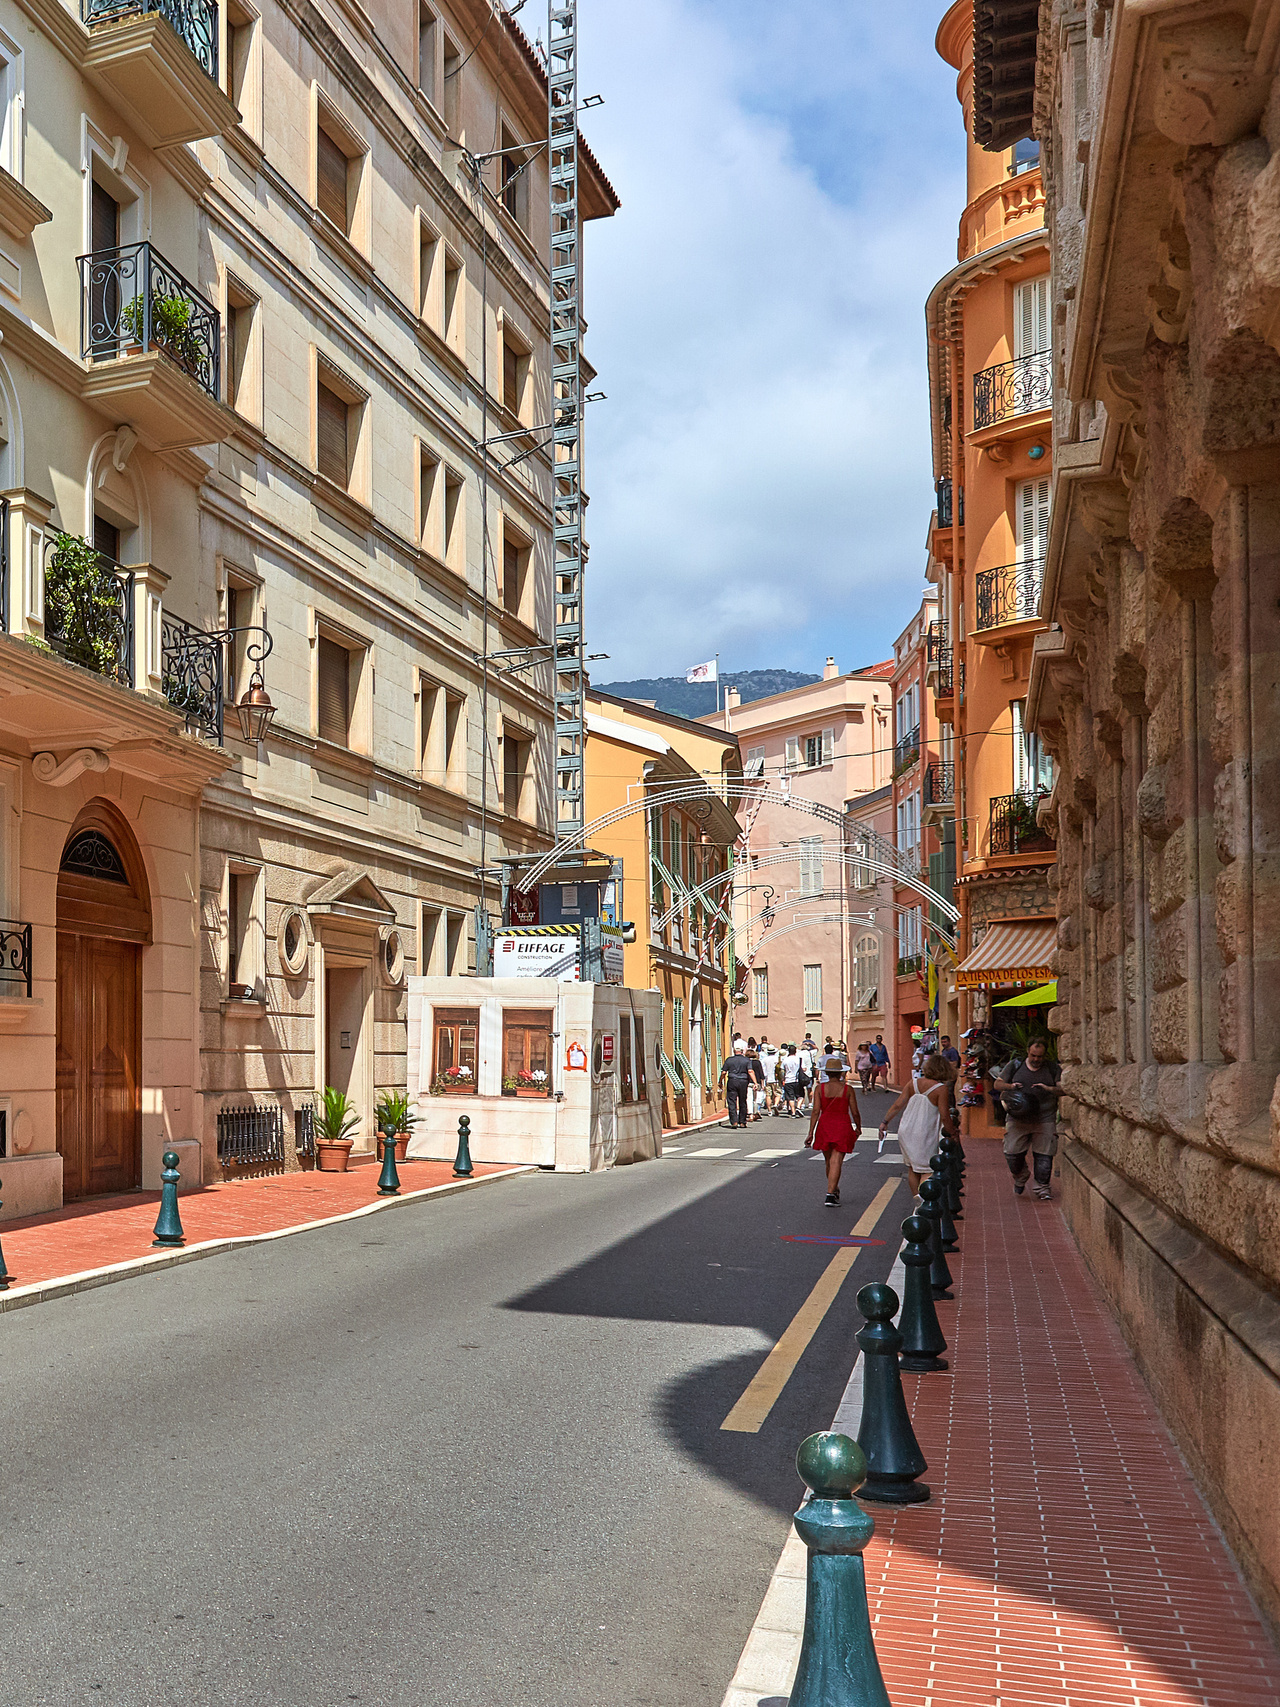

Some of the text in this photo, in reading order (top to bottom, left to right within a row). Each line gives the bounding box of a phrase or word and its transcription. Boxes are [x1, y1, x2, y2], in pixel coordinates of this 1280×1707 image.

[517, 943, 566, 953] EIFFAGE
[957, 972, 968, 982] LA
[970, 970, 1001, 982] TIENDA
[1003, 969, 1015, 980] DE
[1016, 968, 1033, 979] LOS
